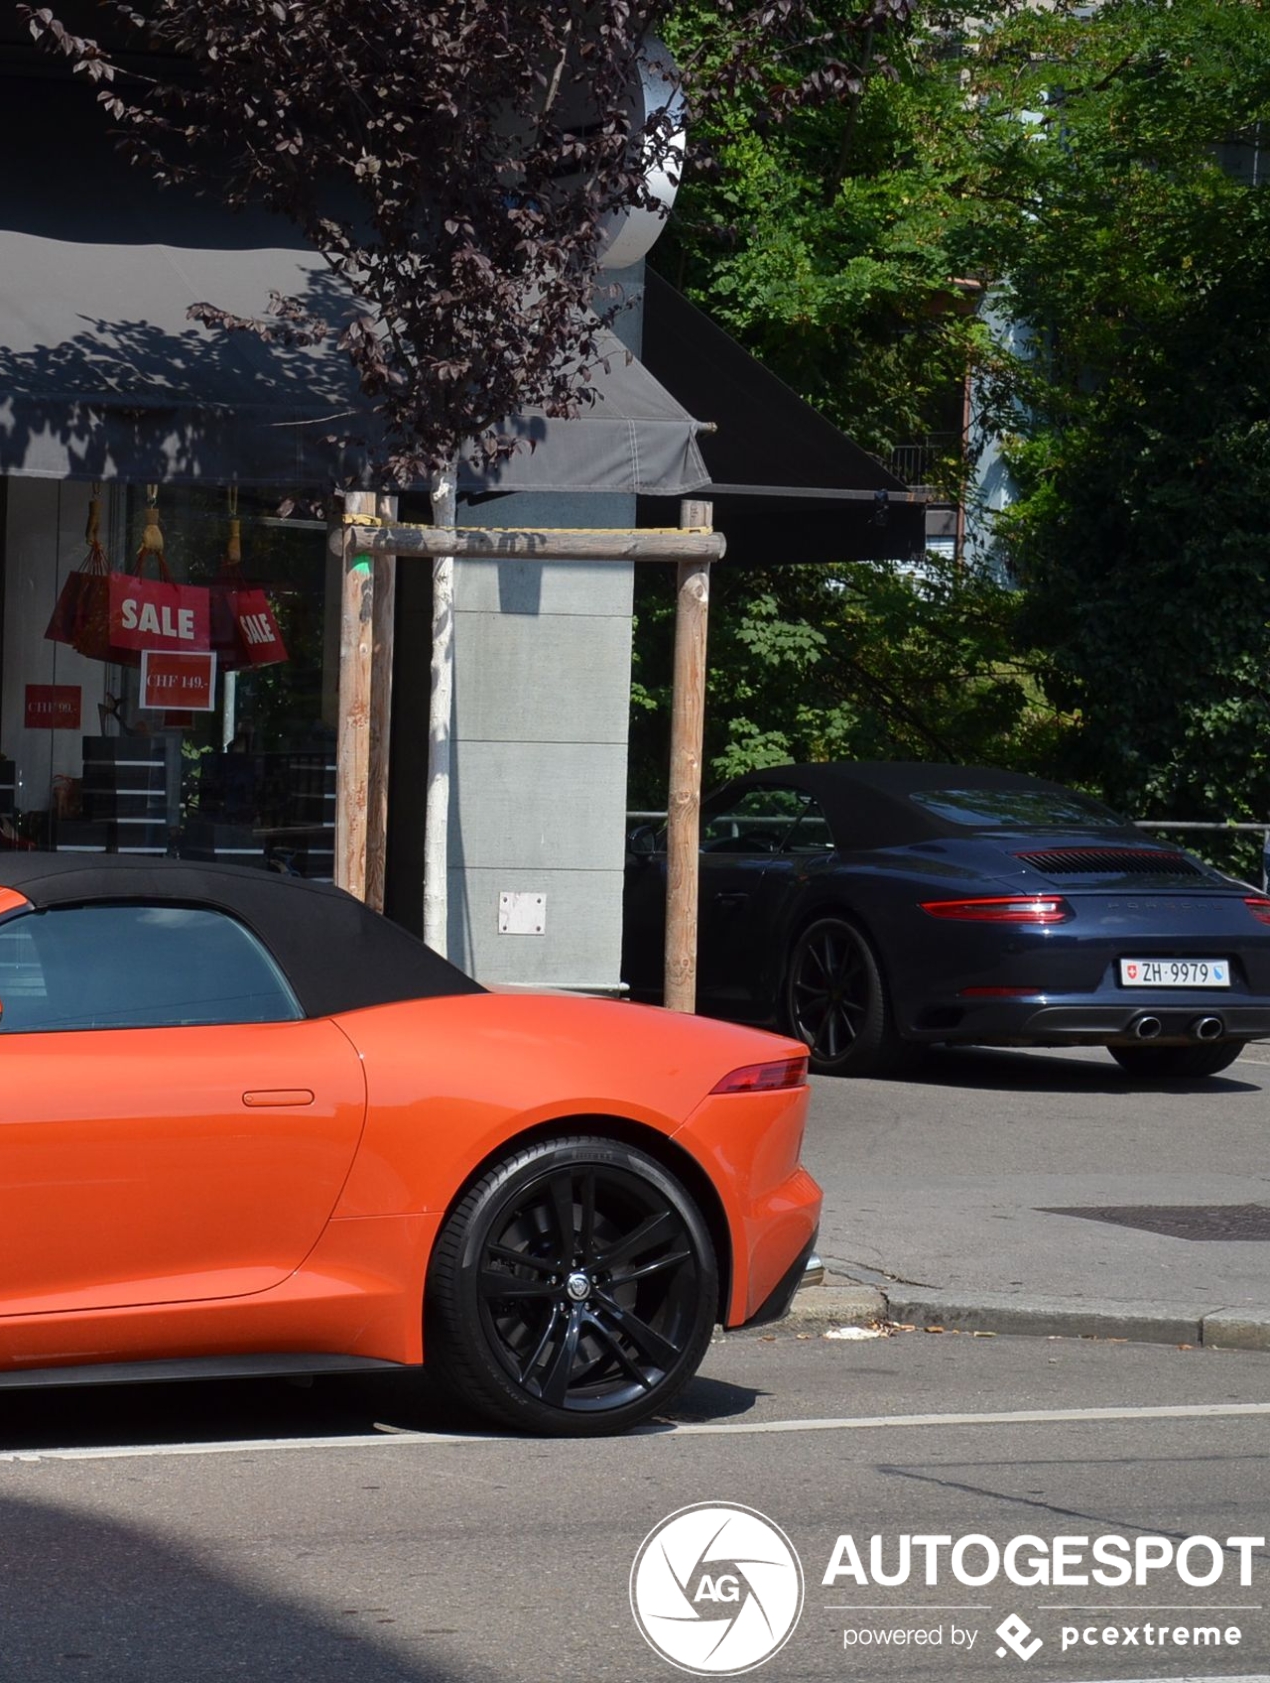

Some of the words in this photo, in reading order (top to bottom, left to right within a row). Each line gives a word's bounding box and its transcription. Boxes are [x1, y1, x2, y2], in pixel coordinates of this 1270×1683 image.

[121, 598, 195, 640] SALE
[239, 613, 276, 645] SALE
[147, 674, 178, 688] CHF
